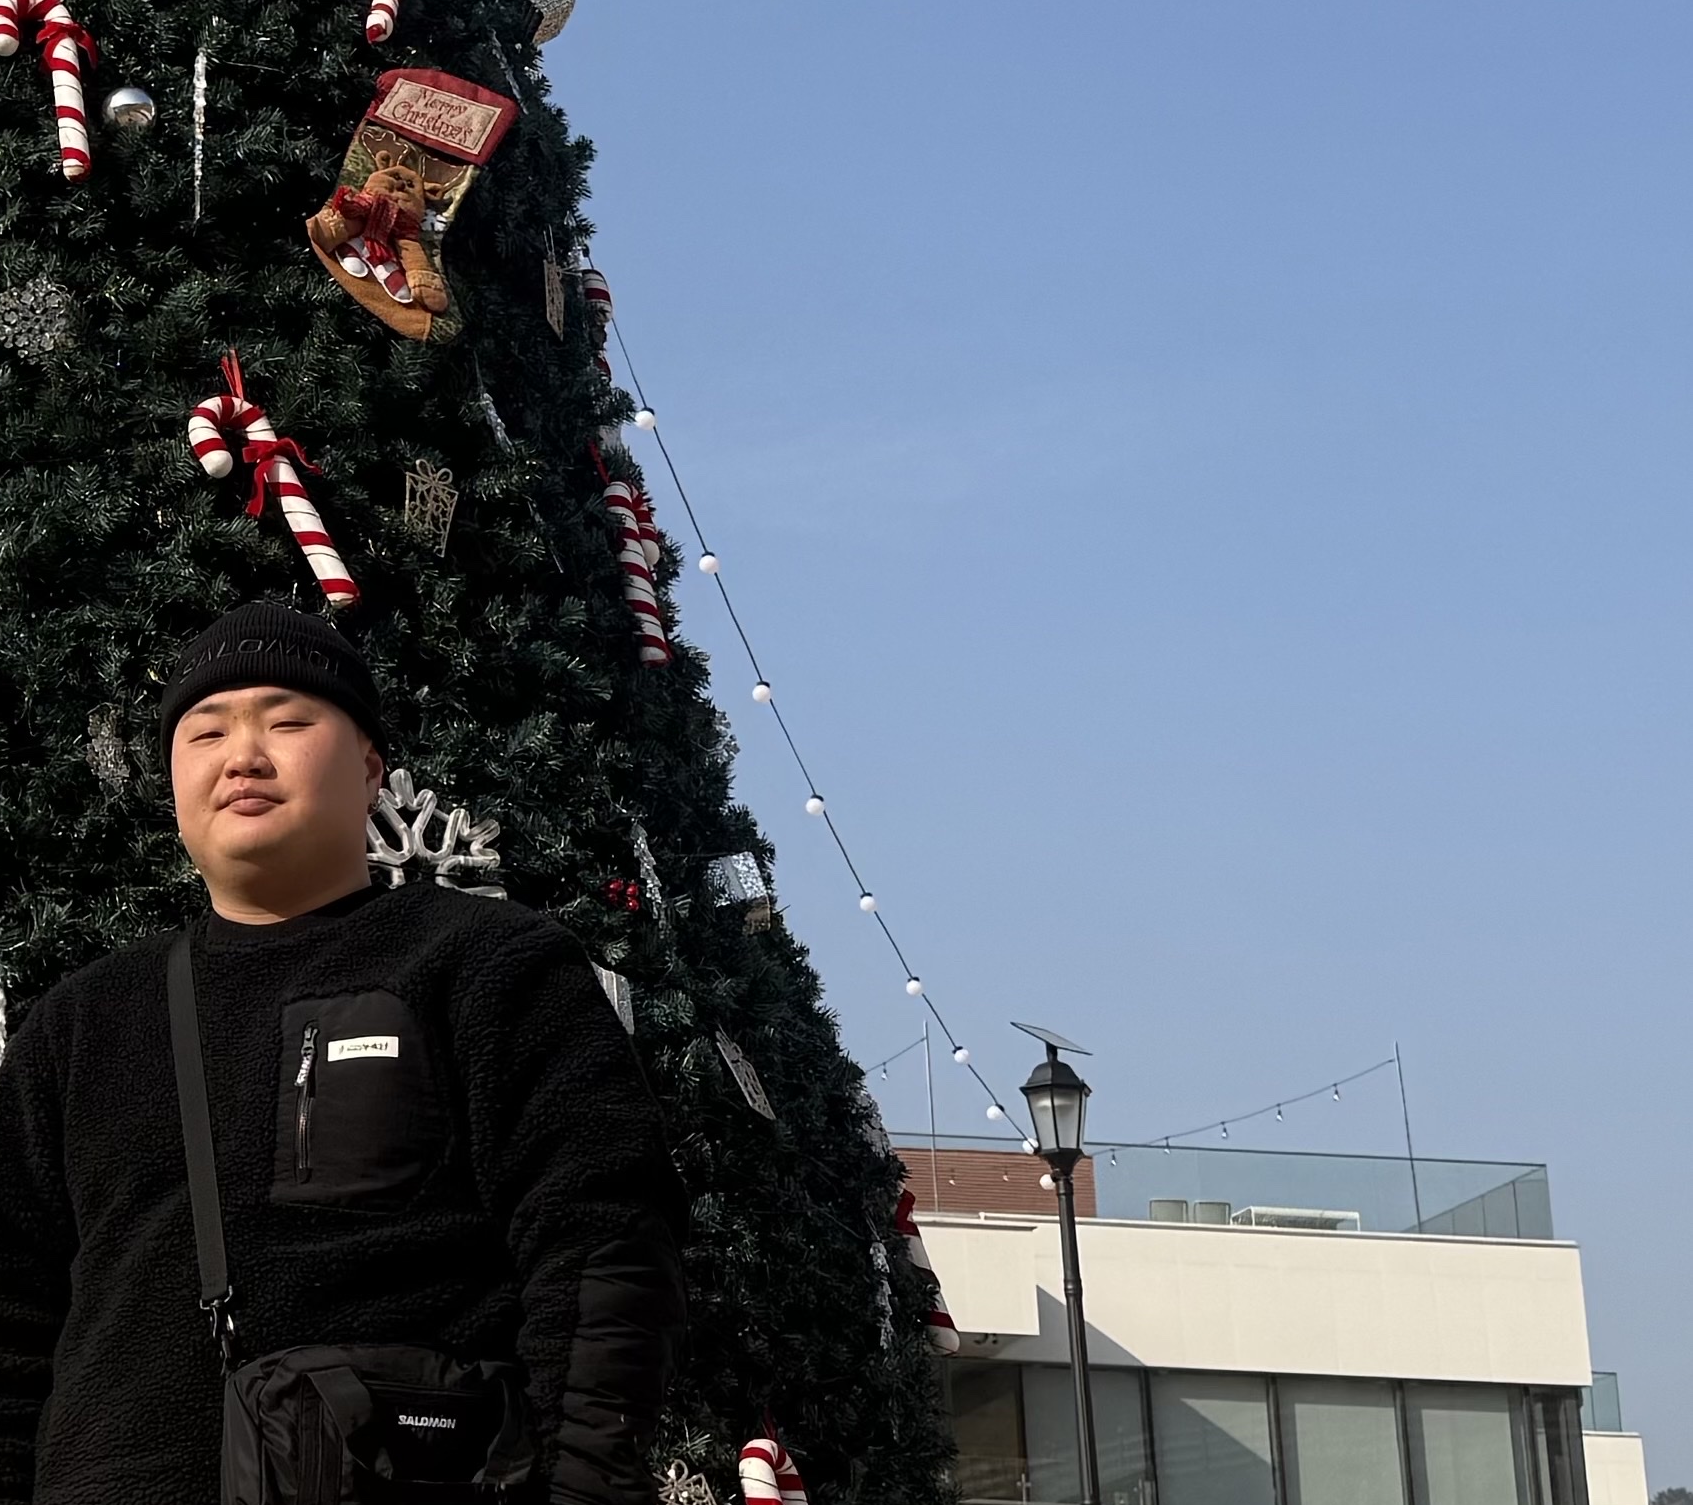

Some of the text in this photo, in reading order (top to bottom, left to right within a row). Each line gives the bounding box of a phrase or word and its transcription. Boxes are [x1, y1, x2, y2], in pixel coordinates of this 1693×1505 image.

[416, 88, 468, 118] Merry
[392, 101, 473, 143] Christmas
[397, 1414, 457, 1429] SALOMON
